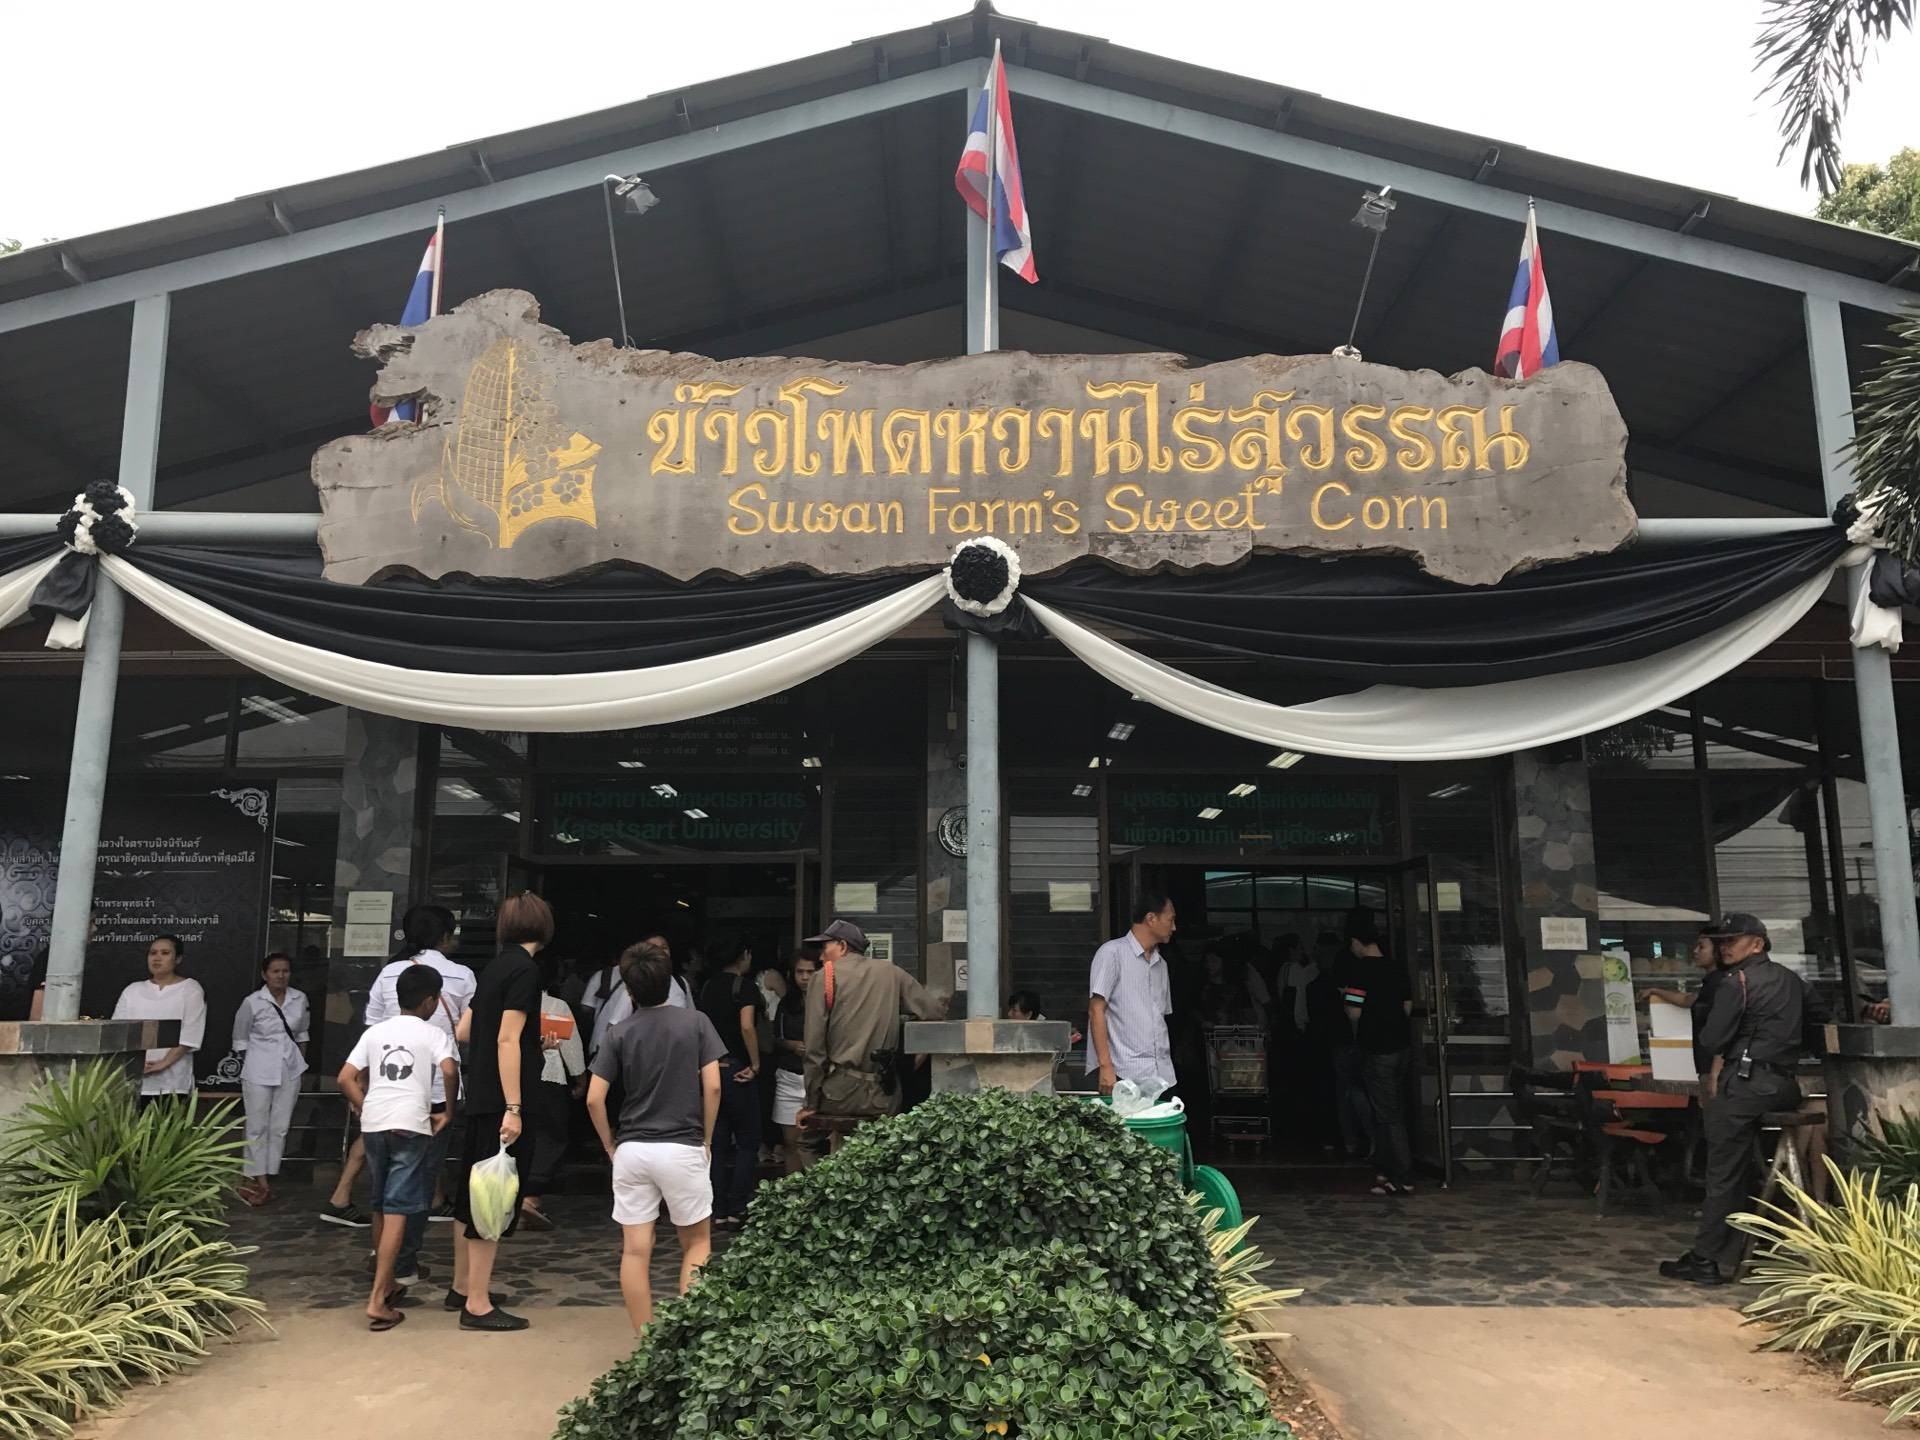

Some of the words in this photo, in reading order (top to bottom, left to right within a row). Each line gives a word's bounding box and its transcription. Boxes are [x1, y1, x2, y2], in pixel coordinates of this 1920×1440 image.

[646, 376, 1530, 495] ข้าวโพดหวานไร่สุวรรณ
[727, 482, 904, 536] Suwan
[928, 487, 1080, 535] Farm's
[1105, 481, 1267, 534] Sweet
[1310, 482, 1449, 531] Corn
[553, 818, 677, 840] Kasetsart
[682, 818, 803, 843] University
